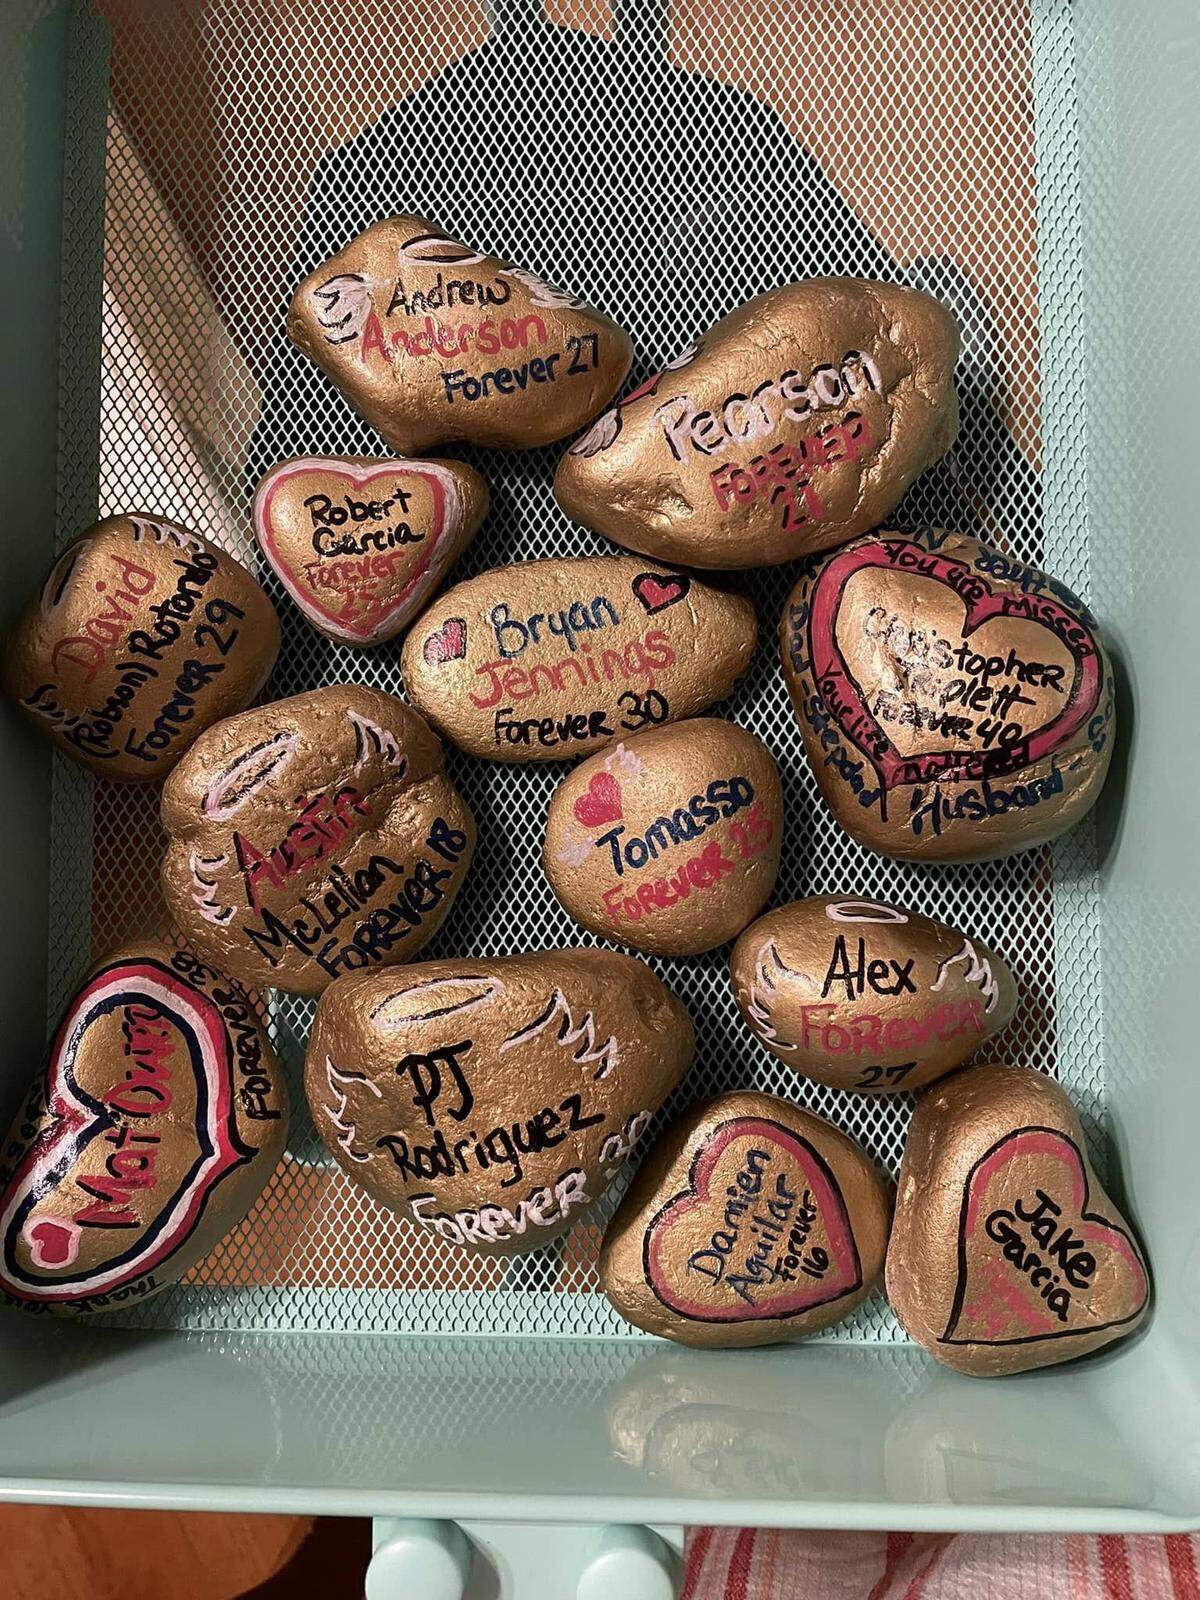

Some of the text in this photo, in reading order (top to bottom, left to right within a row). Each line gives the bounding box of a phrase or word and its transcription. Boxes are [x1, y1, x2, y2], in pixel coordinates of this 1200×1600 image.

[386, 273, 511, 317] Andrew
[361, 311, 549, 364] Anderson
[440, 332, 601, 403] Forever 27
[652, 348, 885, 467] Pearson
[303, 487, 413, 528] Robert
[311, 521, 426, 558] Garcia
[50, 553, 157, 686] David
[193, 597, 248, 657] 29
[489, 595, 622, 660] Bryan
[467, 630, 679, 711] Jennings
[616, 689, 671, 732] 30
[232, 785, 374, 918] Austin
[595, 775, 756, 877] Tomasso
[821, 934, 918, 1002] Alex
[395, 1038, 474, 1128] PJ
[853, 1060, 919, 1090] 27
[376, 1094, 606, 1188] Rodriguez
[686, 1148, 773, 1287] Damien
[725, 1173, 797, 1308] Aguilar
[1013, 1188, 1098, 1291] Jake
[799, 1245, 831, 1280] 16
[984, 1208, 1073, 1324] Garcia
